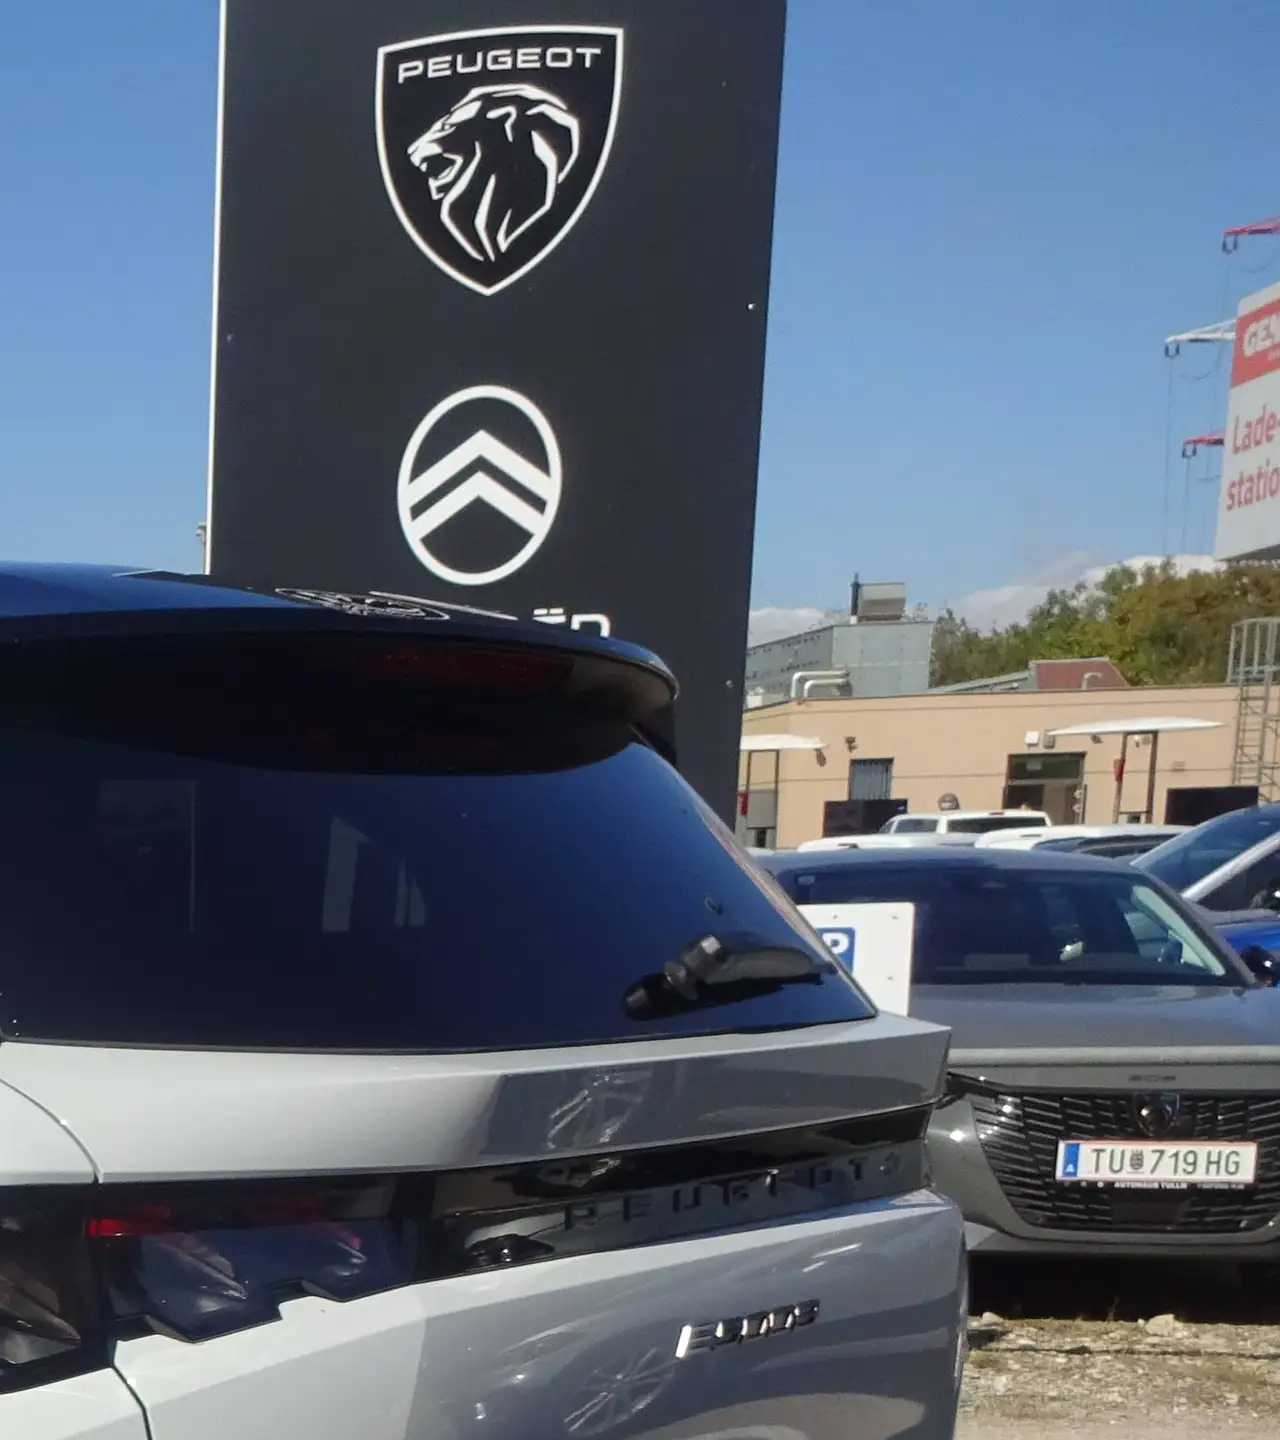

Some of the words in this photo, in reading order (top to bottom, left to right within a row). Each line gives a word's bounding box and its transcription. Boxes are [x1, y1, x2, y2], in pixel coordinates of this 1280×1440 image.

[398, 46, 602, 84] PEUGEOT
[1065, 1164, 1075, 1173] A
[1090, 1147, 1126, 1176] TU
[1148, 1148, 1199, 1176] 719
[1205, 1149, 1242, 1176] HG
